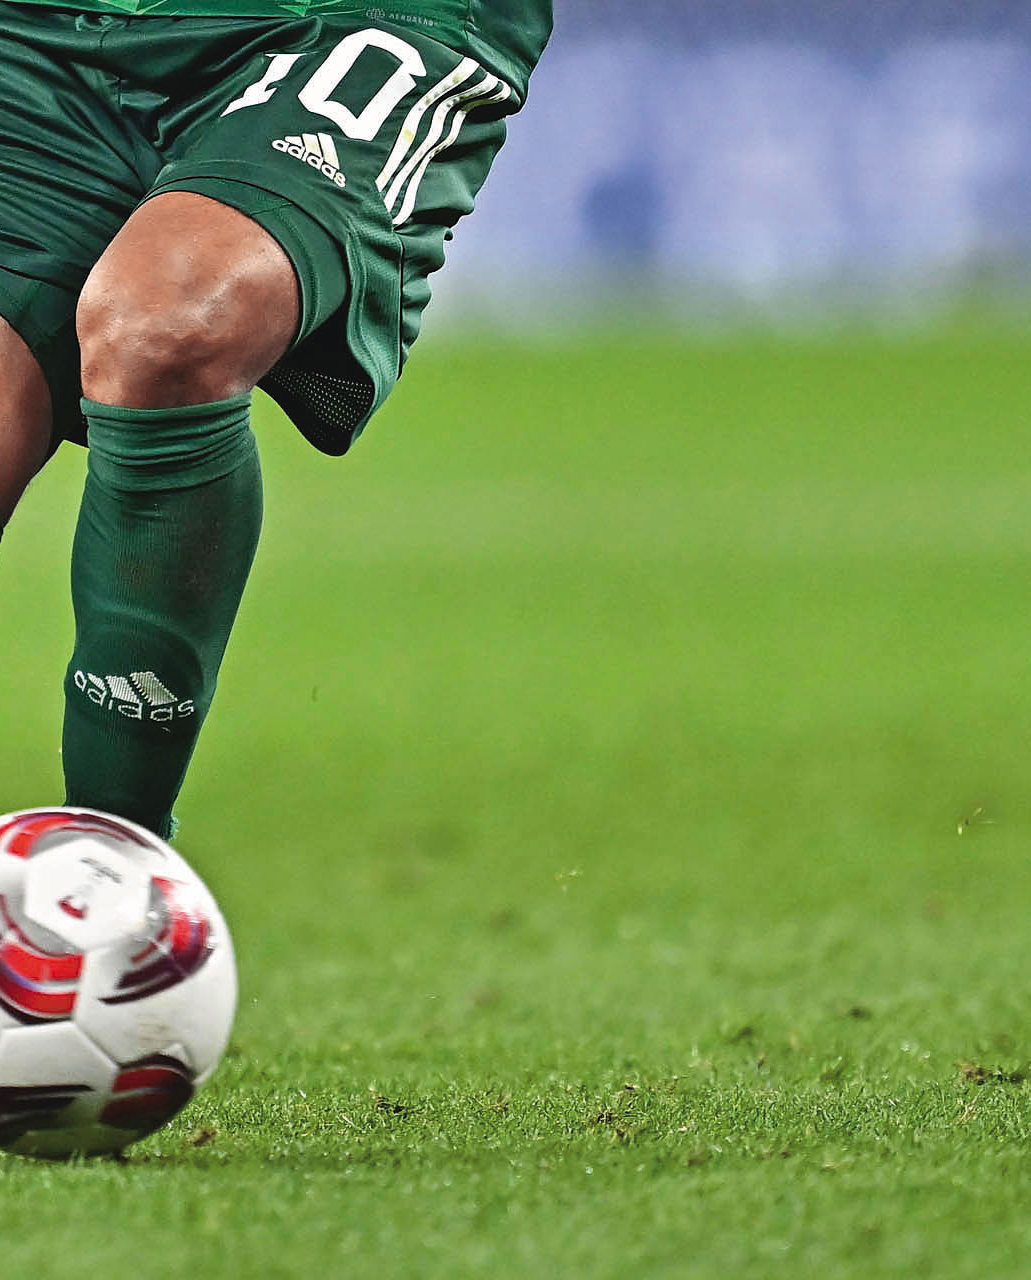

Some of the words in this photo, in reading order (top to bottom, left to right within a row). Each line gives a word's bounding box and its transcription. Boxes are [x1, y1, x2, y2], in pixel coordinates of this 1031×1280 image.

[220, 27, 428, 142] 10
[271, 139, 346, 188] adidas
[73, 670, 195, 722] adidas
